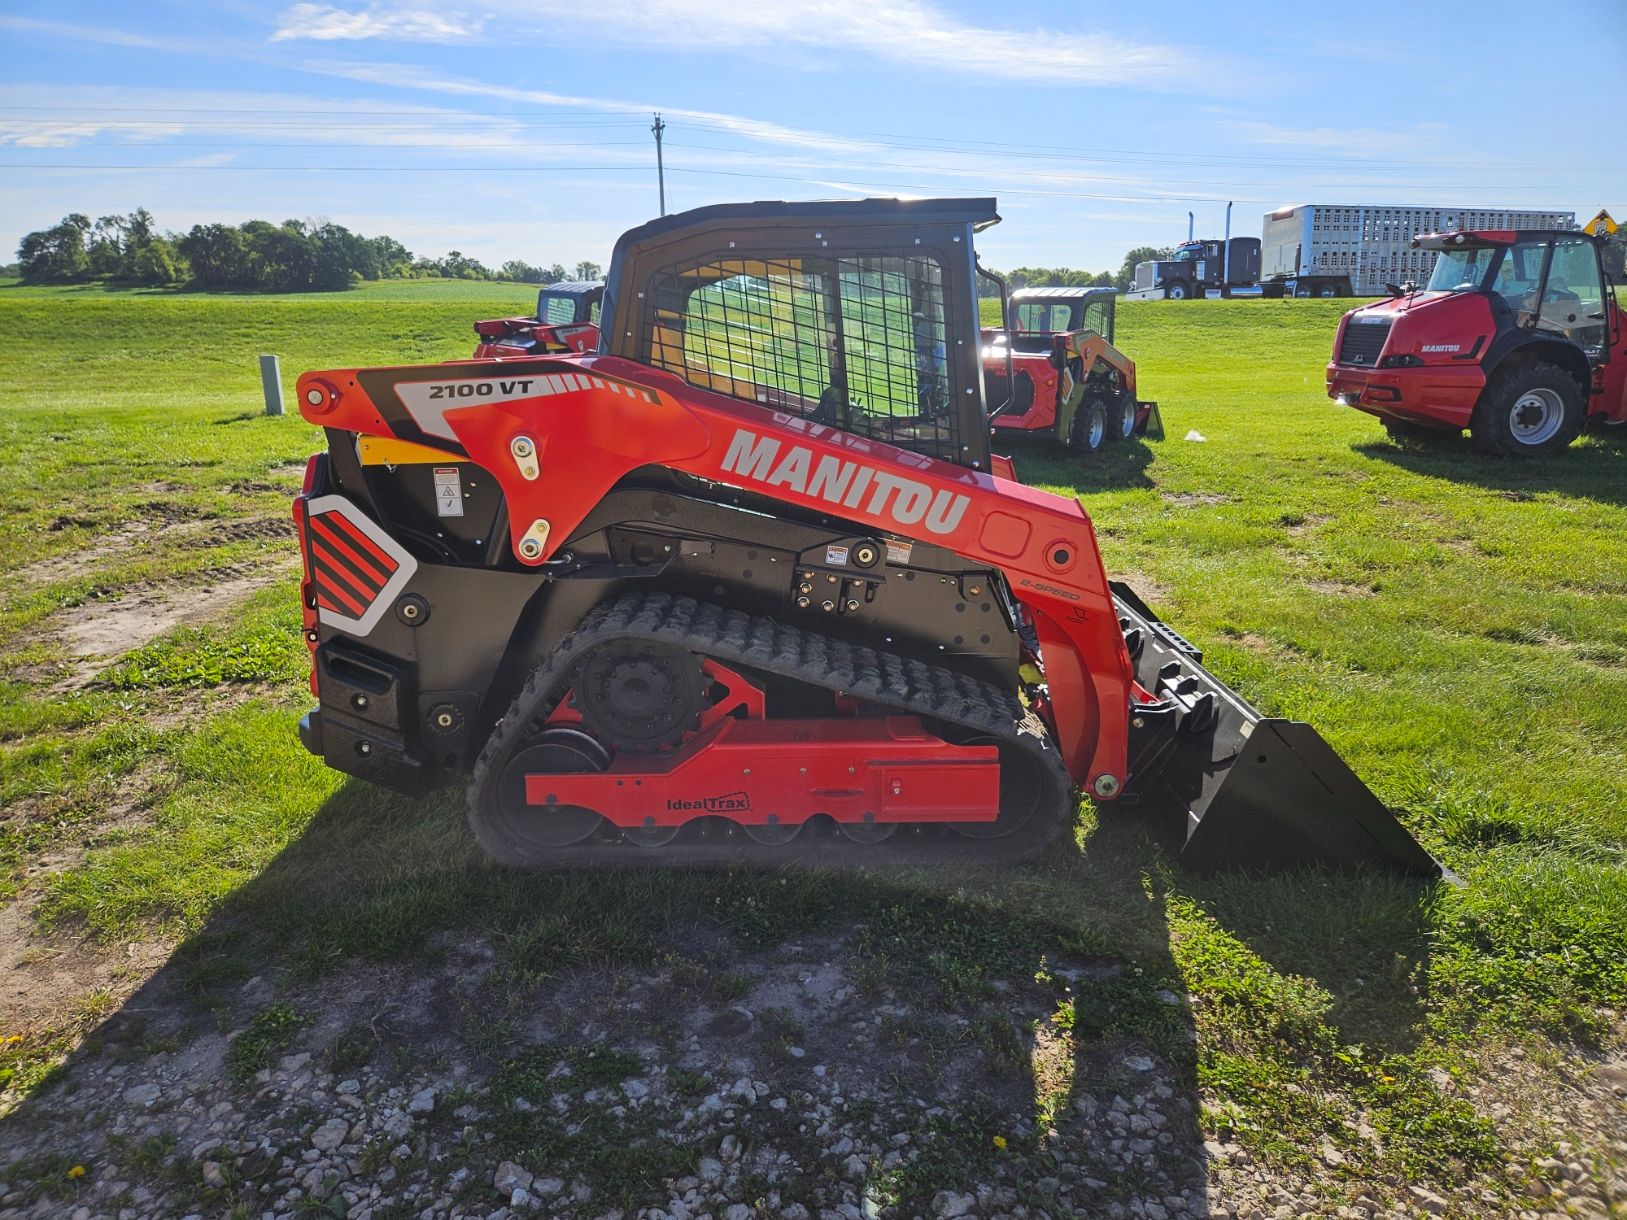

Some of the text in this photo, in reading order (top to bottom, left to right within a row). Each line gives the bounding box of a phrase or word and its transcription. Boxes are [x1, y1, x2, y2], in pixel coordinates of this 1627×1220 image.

[1421, 344, 1460, 353] MANITOU
[429, 380, 534, 399] 2100 VT
[720, 428, 971, 535] MANITOU
[667, 798, 745, 810] IdealTrax
